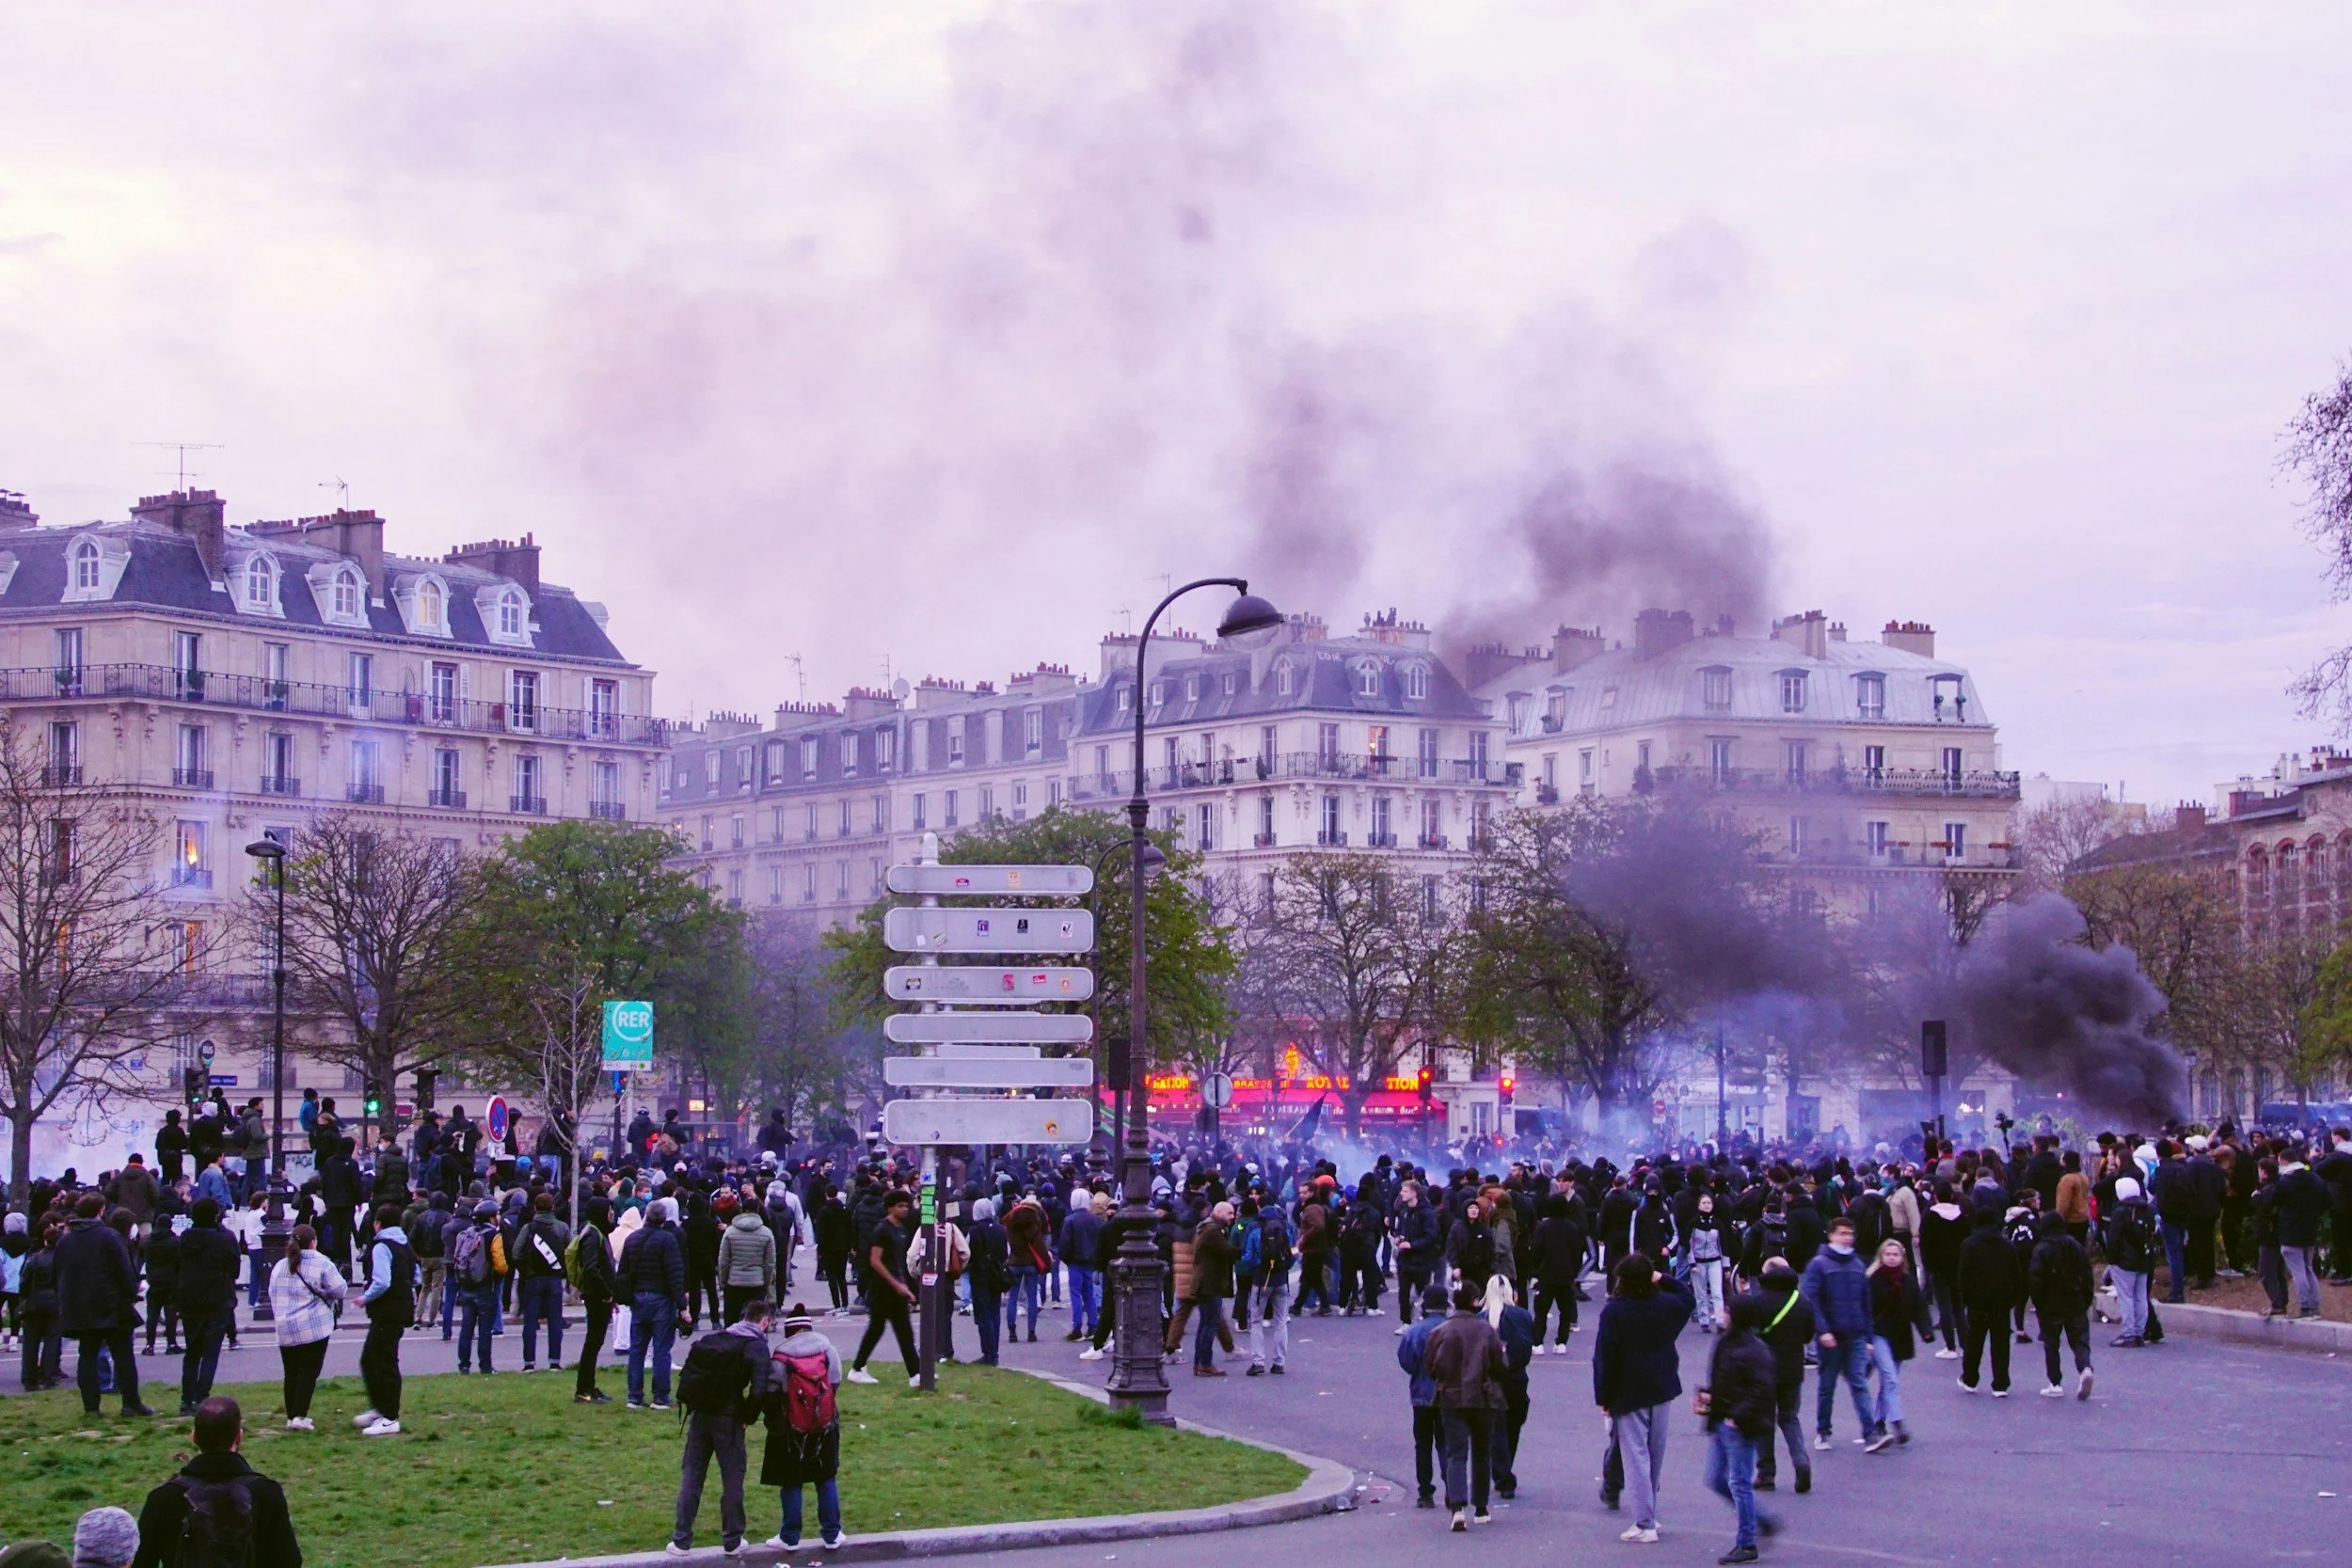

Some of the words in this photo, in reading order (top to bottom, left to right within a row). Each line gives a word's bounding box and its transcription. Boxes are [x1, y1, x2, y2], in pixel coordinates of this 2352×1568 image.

[617, 1011, 650, 1028] RER
[202, 1045, 214, 1054] BUS
[1233, 1079, 1290, 1088] BRASSEIE
